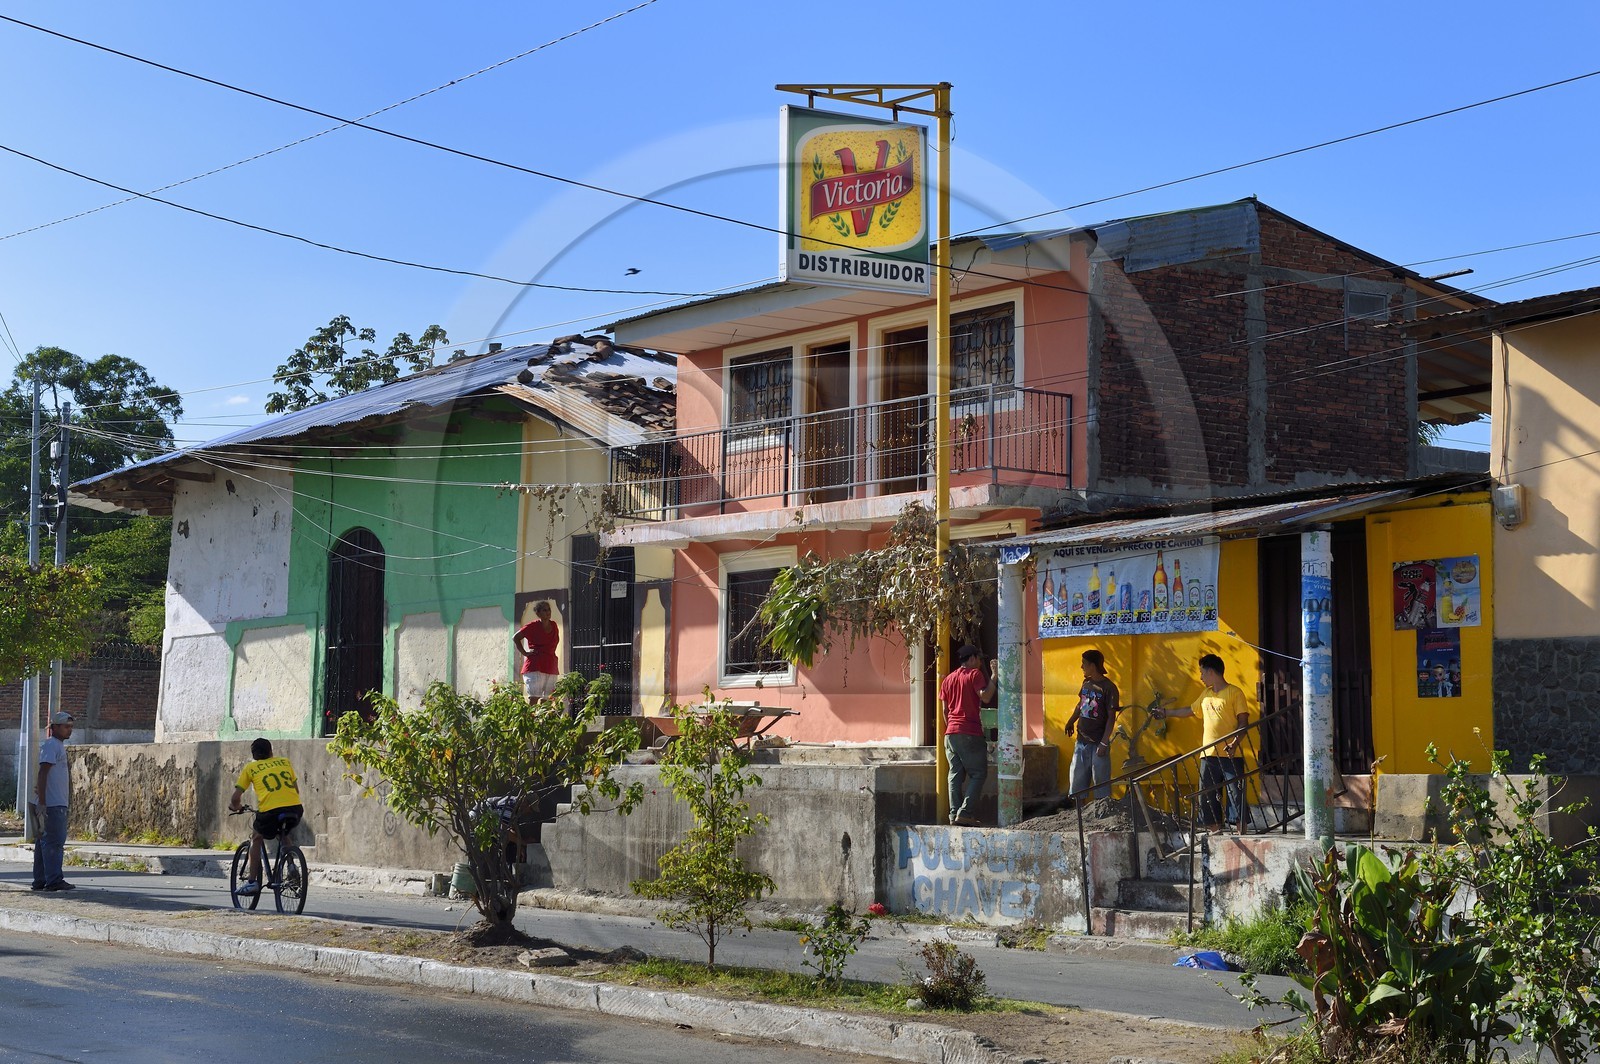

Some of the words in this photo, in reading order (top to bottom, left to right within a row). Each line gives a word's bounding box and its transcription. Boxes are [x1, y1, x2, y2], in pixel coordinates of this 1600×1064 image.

[823, 173, 903, 208] Victoria
[799, 253, 925, 283] DISTRIBUIDOR
[1076, 547, 1085, 556] SE
[1123, 542, 1153, 551] PRECIO
[1155, 541, 1166, 549] DE
[1089, 613, 1101, 624] 360
